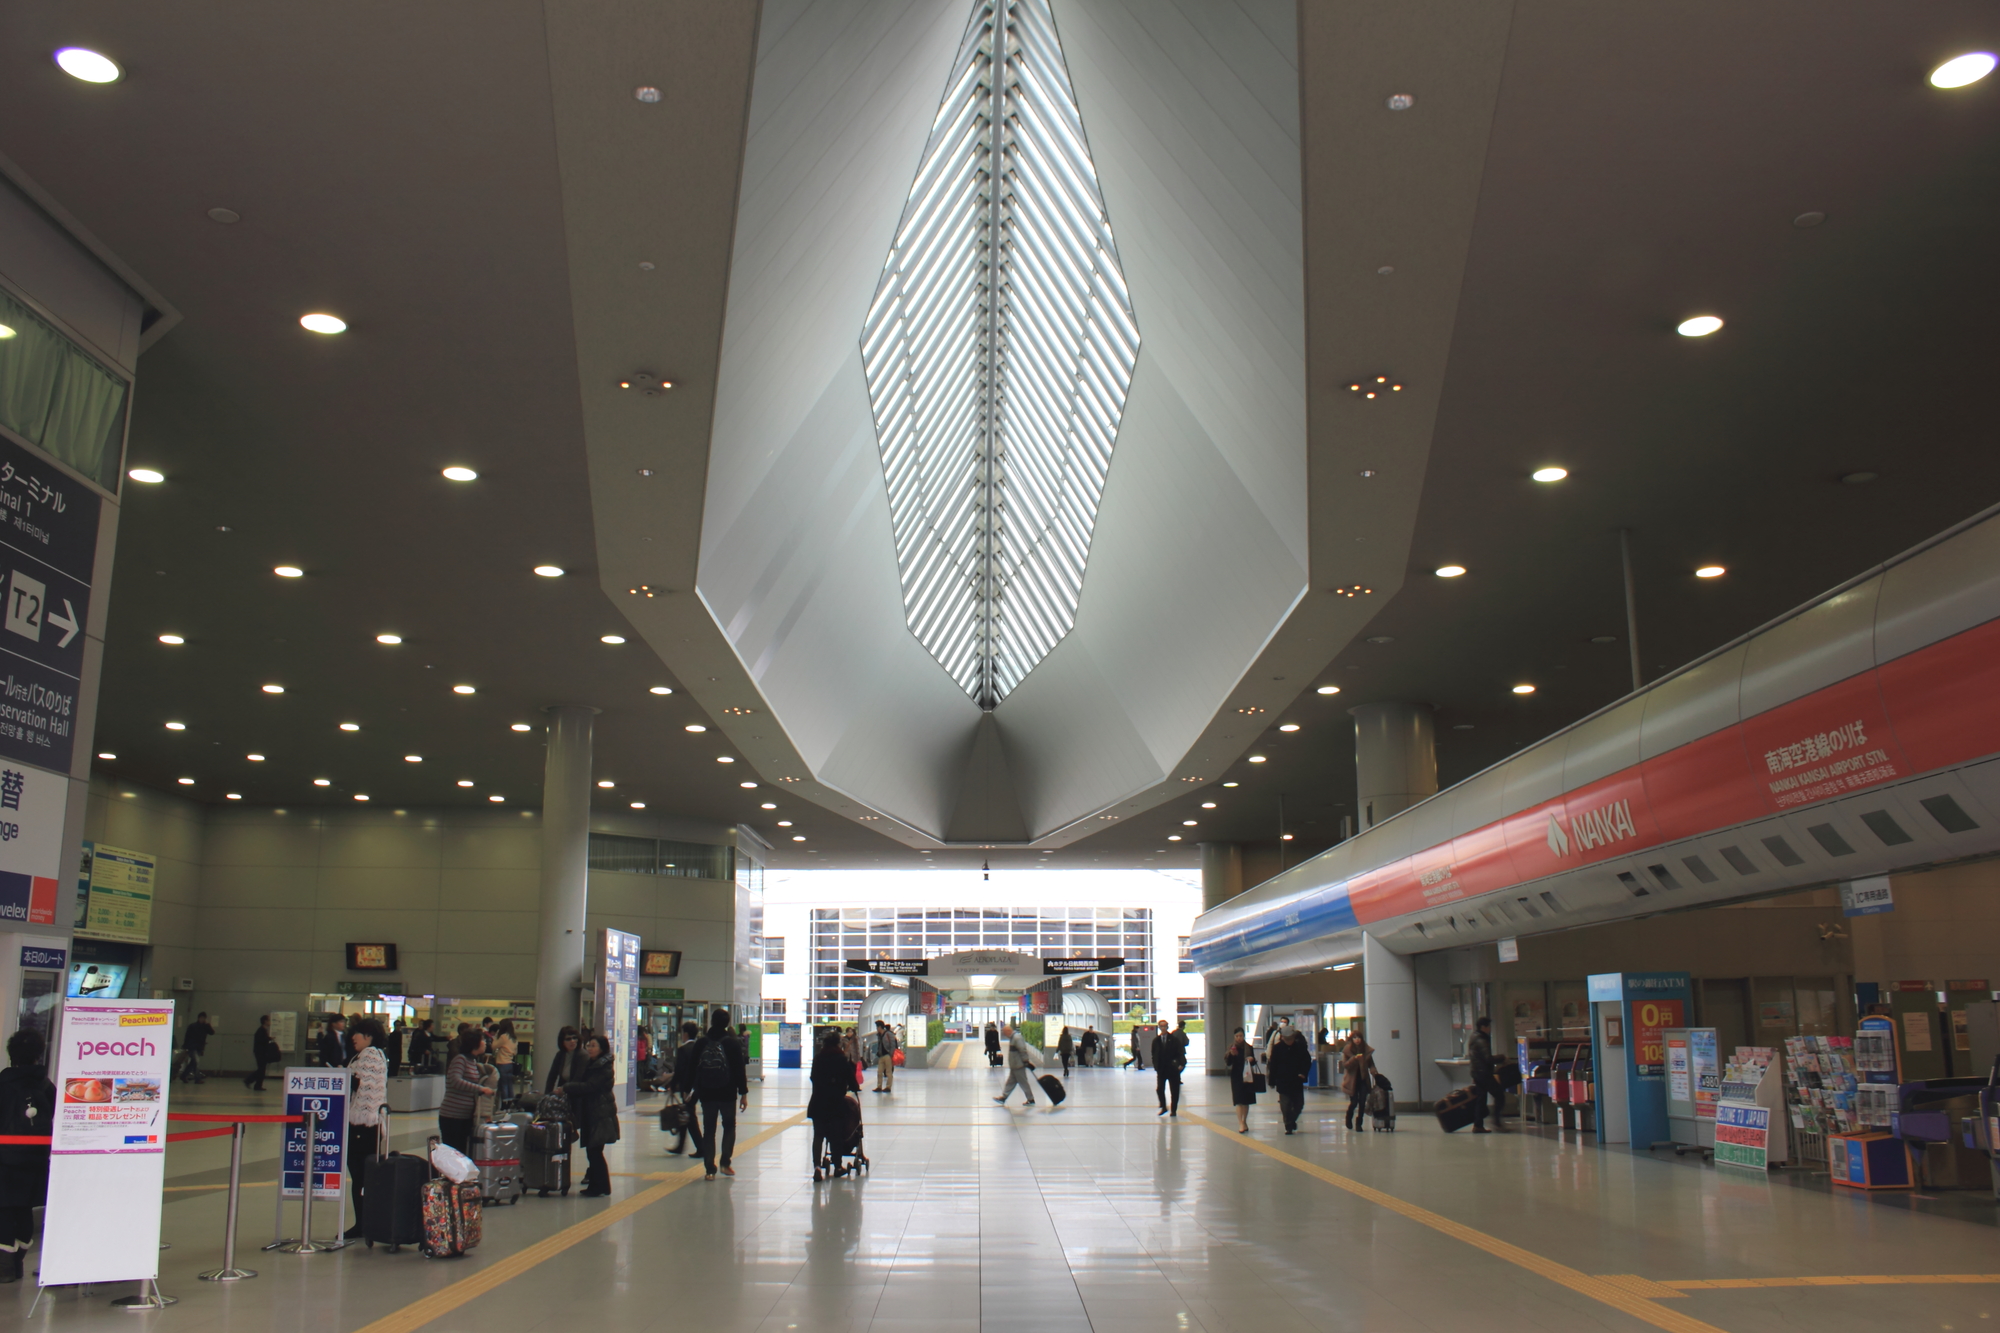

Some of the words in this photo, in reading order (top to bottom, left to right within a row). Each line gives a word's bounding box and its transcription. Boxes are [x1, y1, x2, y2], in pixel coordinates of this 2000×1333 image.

[1, 462, 66, 513] ターミナル
[26, 502, 31, 517] 1
[13, 516, 50, 545] 제1터미널
[13, 587, 40, 627] T2
[50, 715, 69, 737] Hall
[1764, 719, 1868, 774] 南海空港線のりば
[1769, 776, 1800, 794] NANKAI
[1797, 766, 1831, 785] KANSAI
[1828, 755, 1866, 777] AIRPORT
[1865, 749, 1890, 766] STN.
[1, 769, 24, 811] 替
[1571, 798, 1637, 852] NANKAI
[24, 950, 63, 964] 本日のレート
[122, 1016, 146, 1024] Peach
[1641, 1004, 1659, 1027] 0
[1661, 1012, 1673, 1026] 円
[77, 1038, 155, 1060] peach
[291, 1077, 343, 1090] 外貨両替
[1737, 1108, 1745, 1124] TO
[294, 1128, 335, 1141] Foeign
[288, 1142, 340, 1154] Excange
